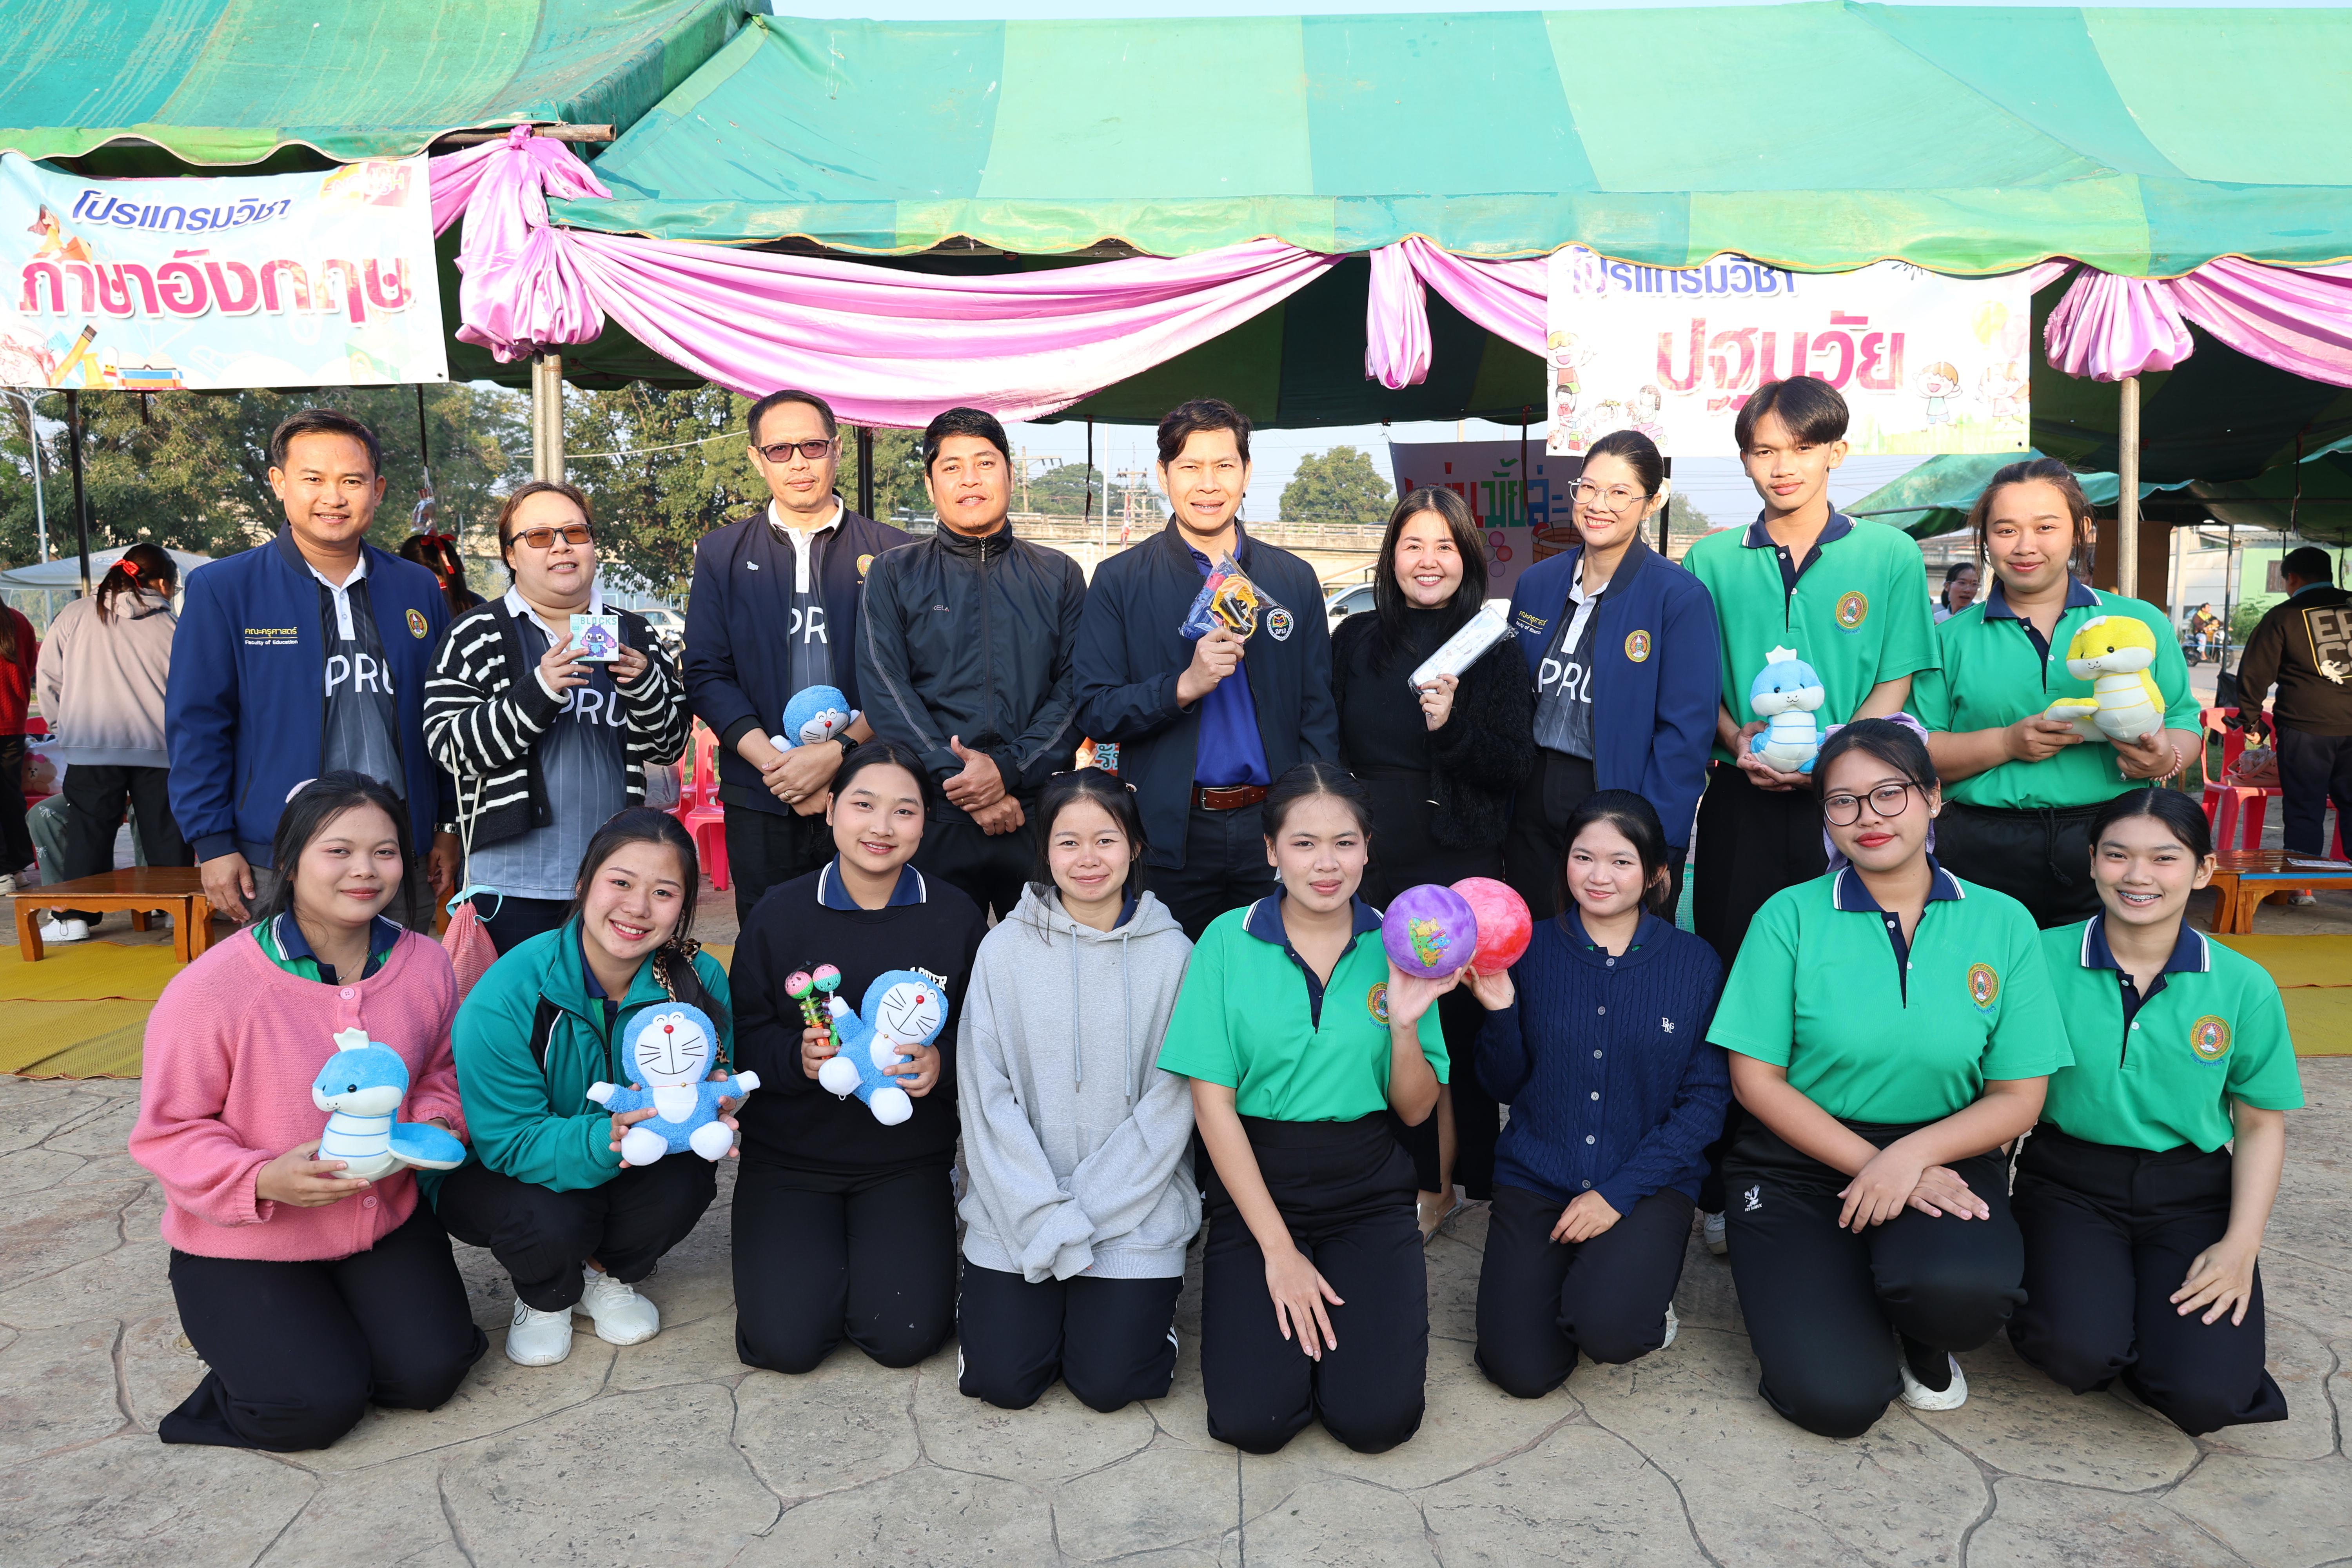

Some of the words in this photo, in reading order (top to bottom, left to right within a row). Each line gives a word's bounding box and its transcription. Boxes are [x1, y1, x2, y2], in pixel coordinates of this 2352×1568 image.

[73, 190, 291, 230] โปรแกรมวิชา
[19, 249, 412, 323] ภาษาอังกฤษ
[1657, 310, 1905, 411] ปฐมวัย
[245, 627, 297, 637] คณะครุศาสตร์
[580, 617, 617, 625] BLOCKS
